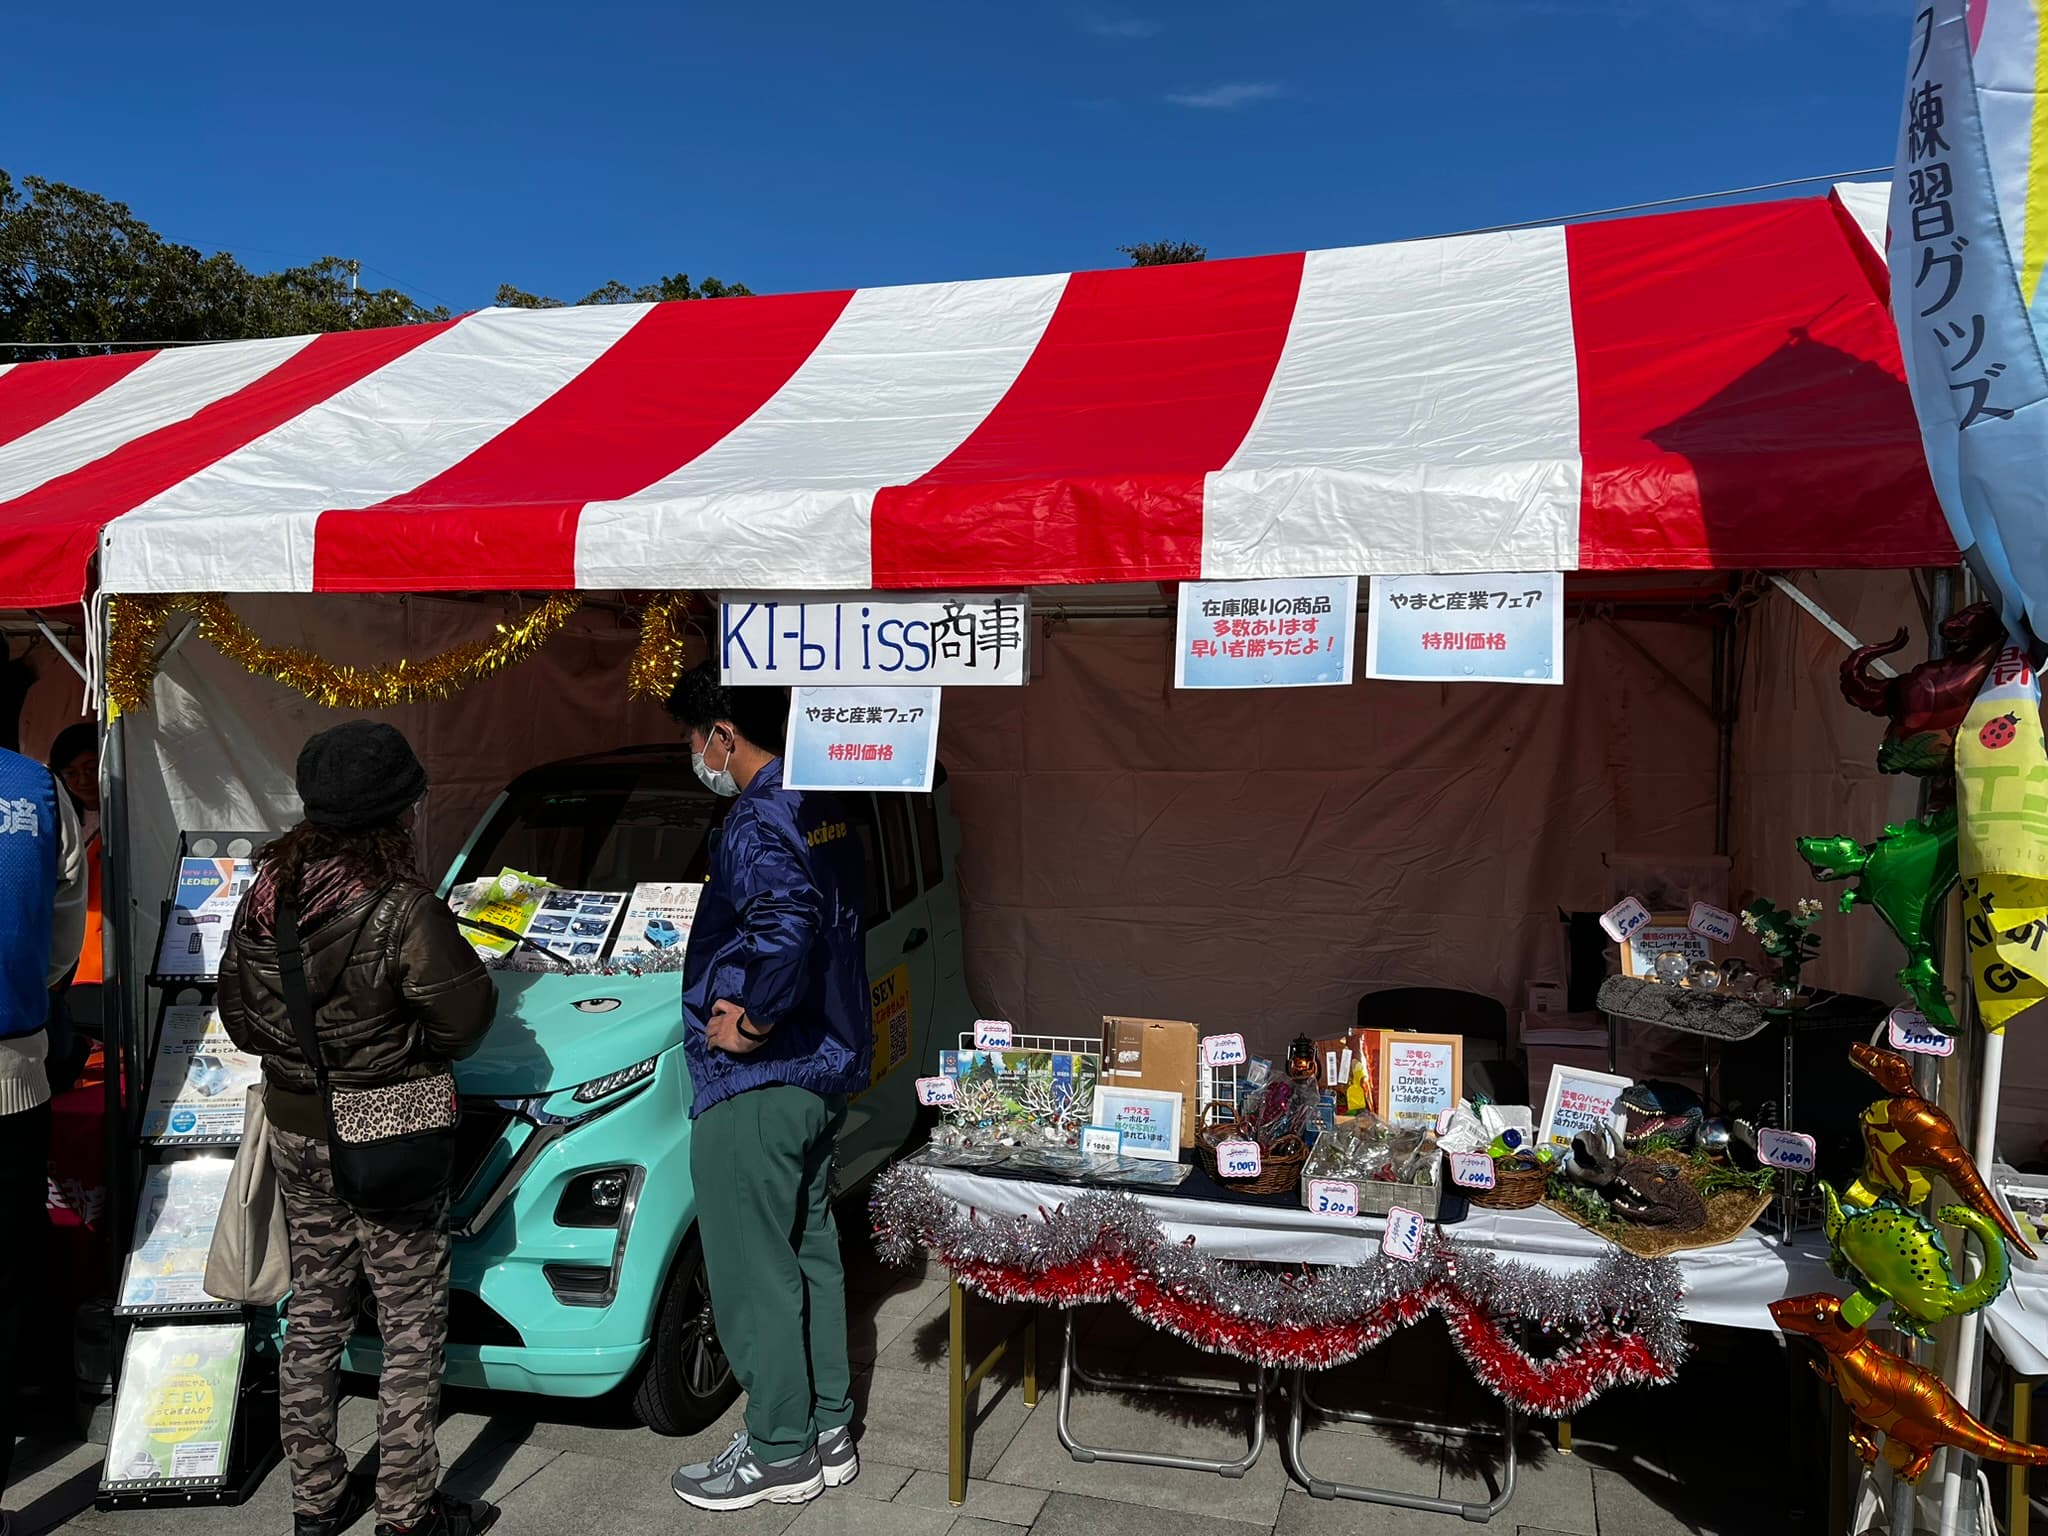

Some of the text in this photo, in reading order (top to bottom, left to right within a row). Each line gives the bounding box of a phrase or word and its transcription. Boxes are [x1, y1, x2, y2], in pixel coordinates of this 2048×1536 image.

[1202, 596, 1332, 618] 在庫限りの商品
[1389, 589, 1543, 611] やまと産業フェア
[1213, 618, 1319, 637] 多数あります
[1190, 636, 1335, 658] 早い者勝ちだよ！
[1421, 631, 1507, 651] 特別価格
[805, 706, 924, 724] やまと産業フェア
[828, 743, 893, 761] 特別価格
[0, 797, 38, 836] 済
[1394, 1059, 1443, 1068] ミニフィギュア
[1407, 1050, 1431, 1059] 恐竜の
[1391, 1085, 1446, 1095] いろんなところ
[1116, 1113, 1157, 1124] キーホルダー
[1122, 1106, 1151, 1116] ガラス玉
[1229, 1161, 1257, 1172] 500円
[1319, 1195, 1354, 1214] 300円
